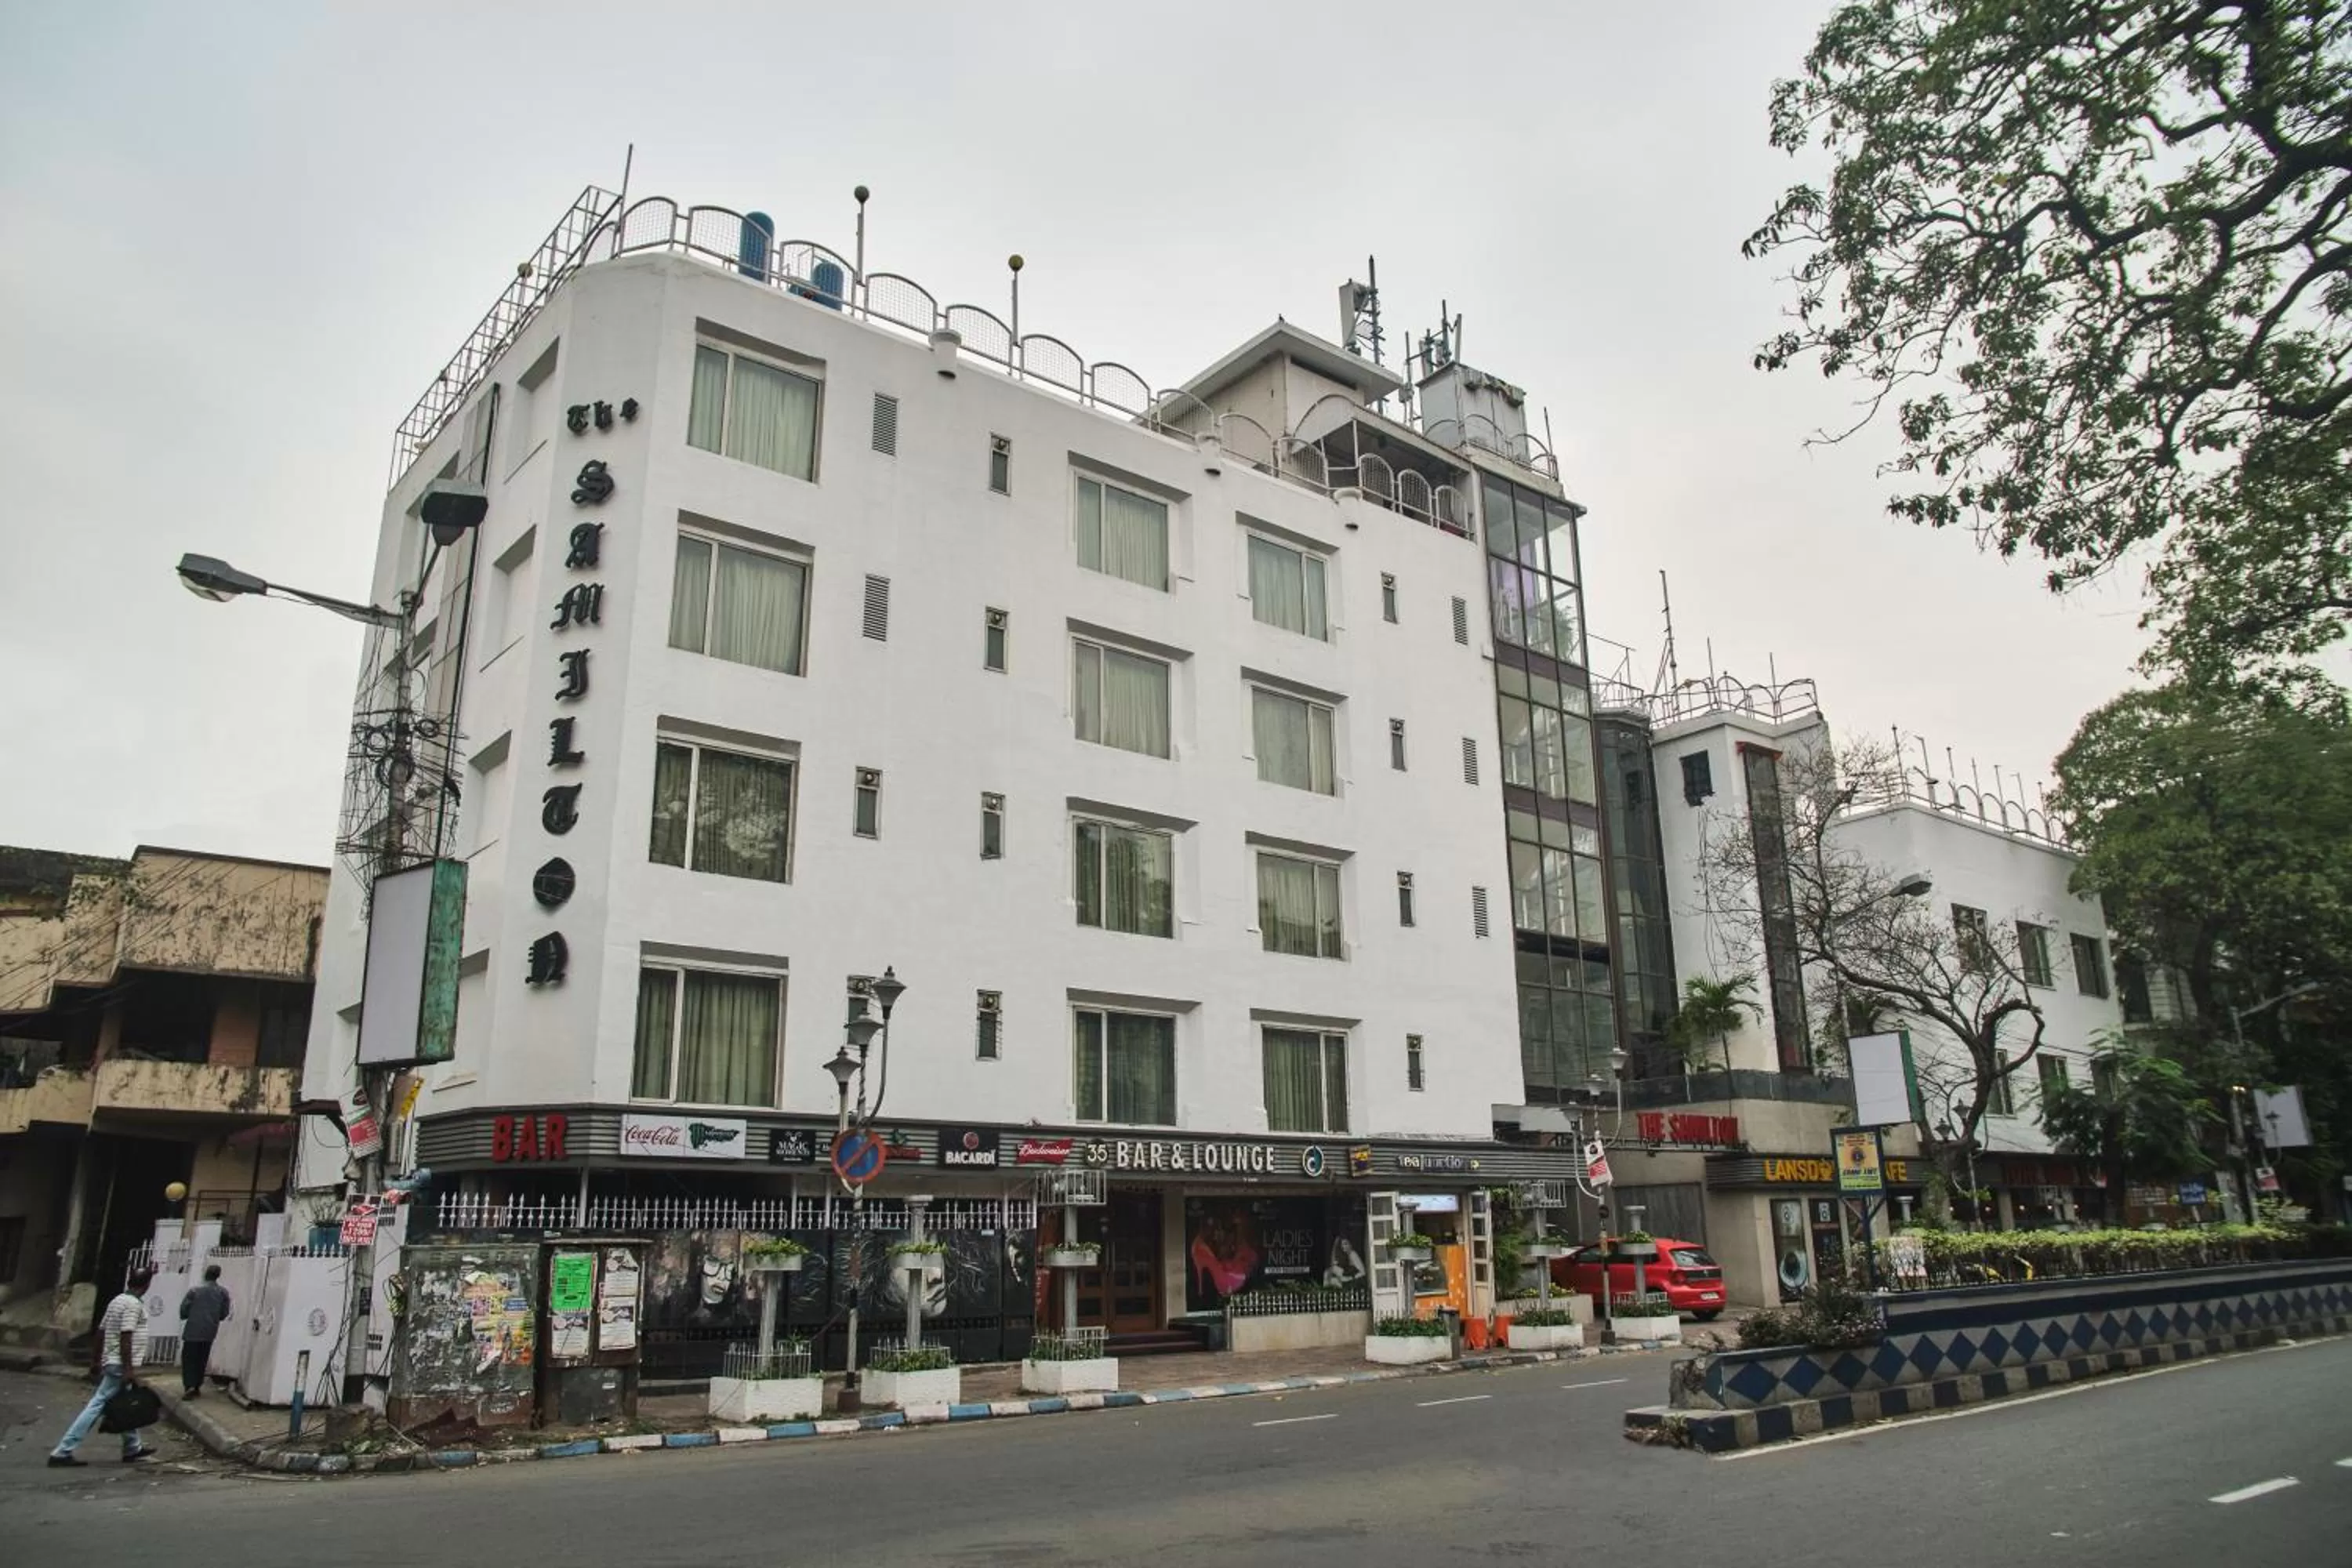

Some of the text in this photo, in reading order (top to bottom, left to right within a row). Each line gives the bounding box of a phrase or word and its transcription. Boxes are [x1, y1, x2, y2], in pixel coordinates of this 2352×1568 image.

[567, 397, 639, 430] The
[491, 1113, 570, 1163] BAR
[1087, 1141, 1276, 1171] 35 BAR & LOUNGE
[1262, 1229, 1314, 1248] LADIES
[1267, 1248, 1309, 1265] NIGHT
